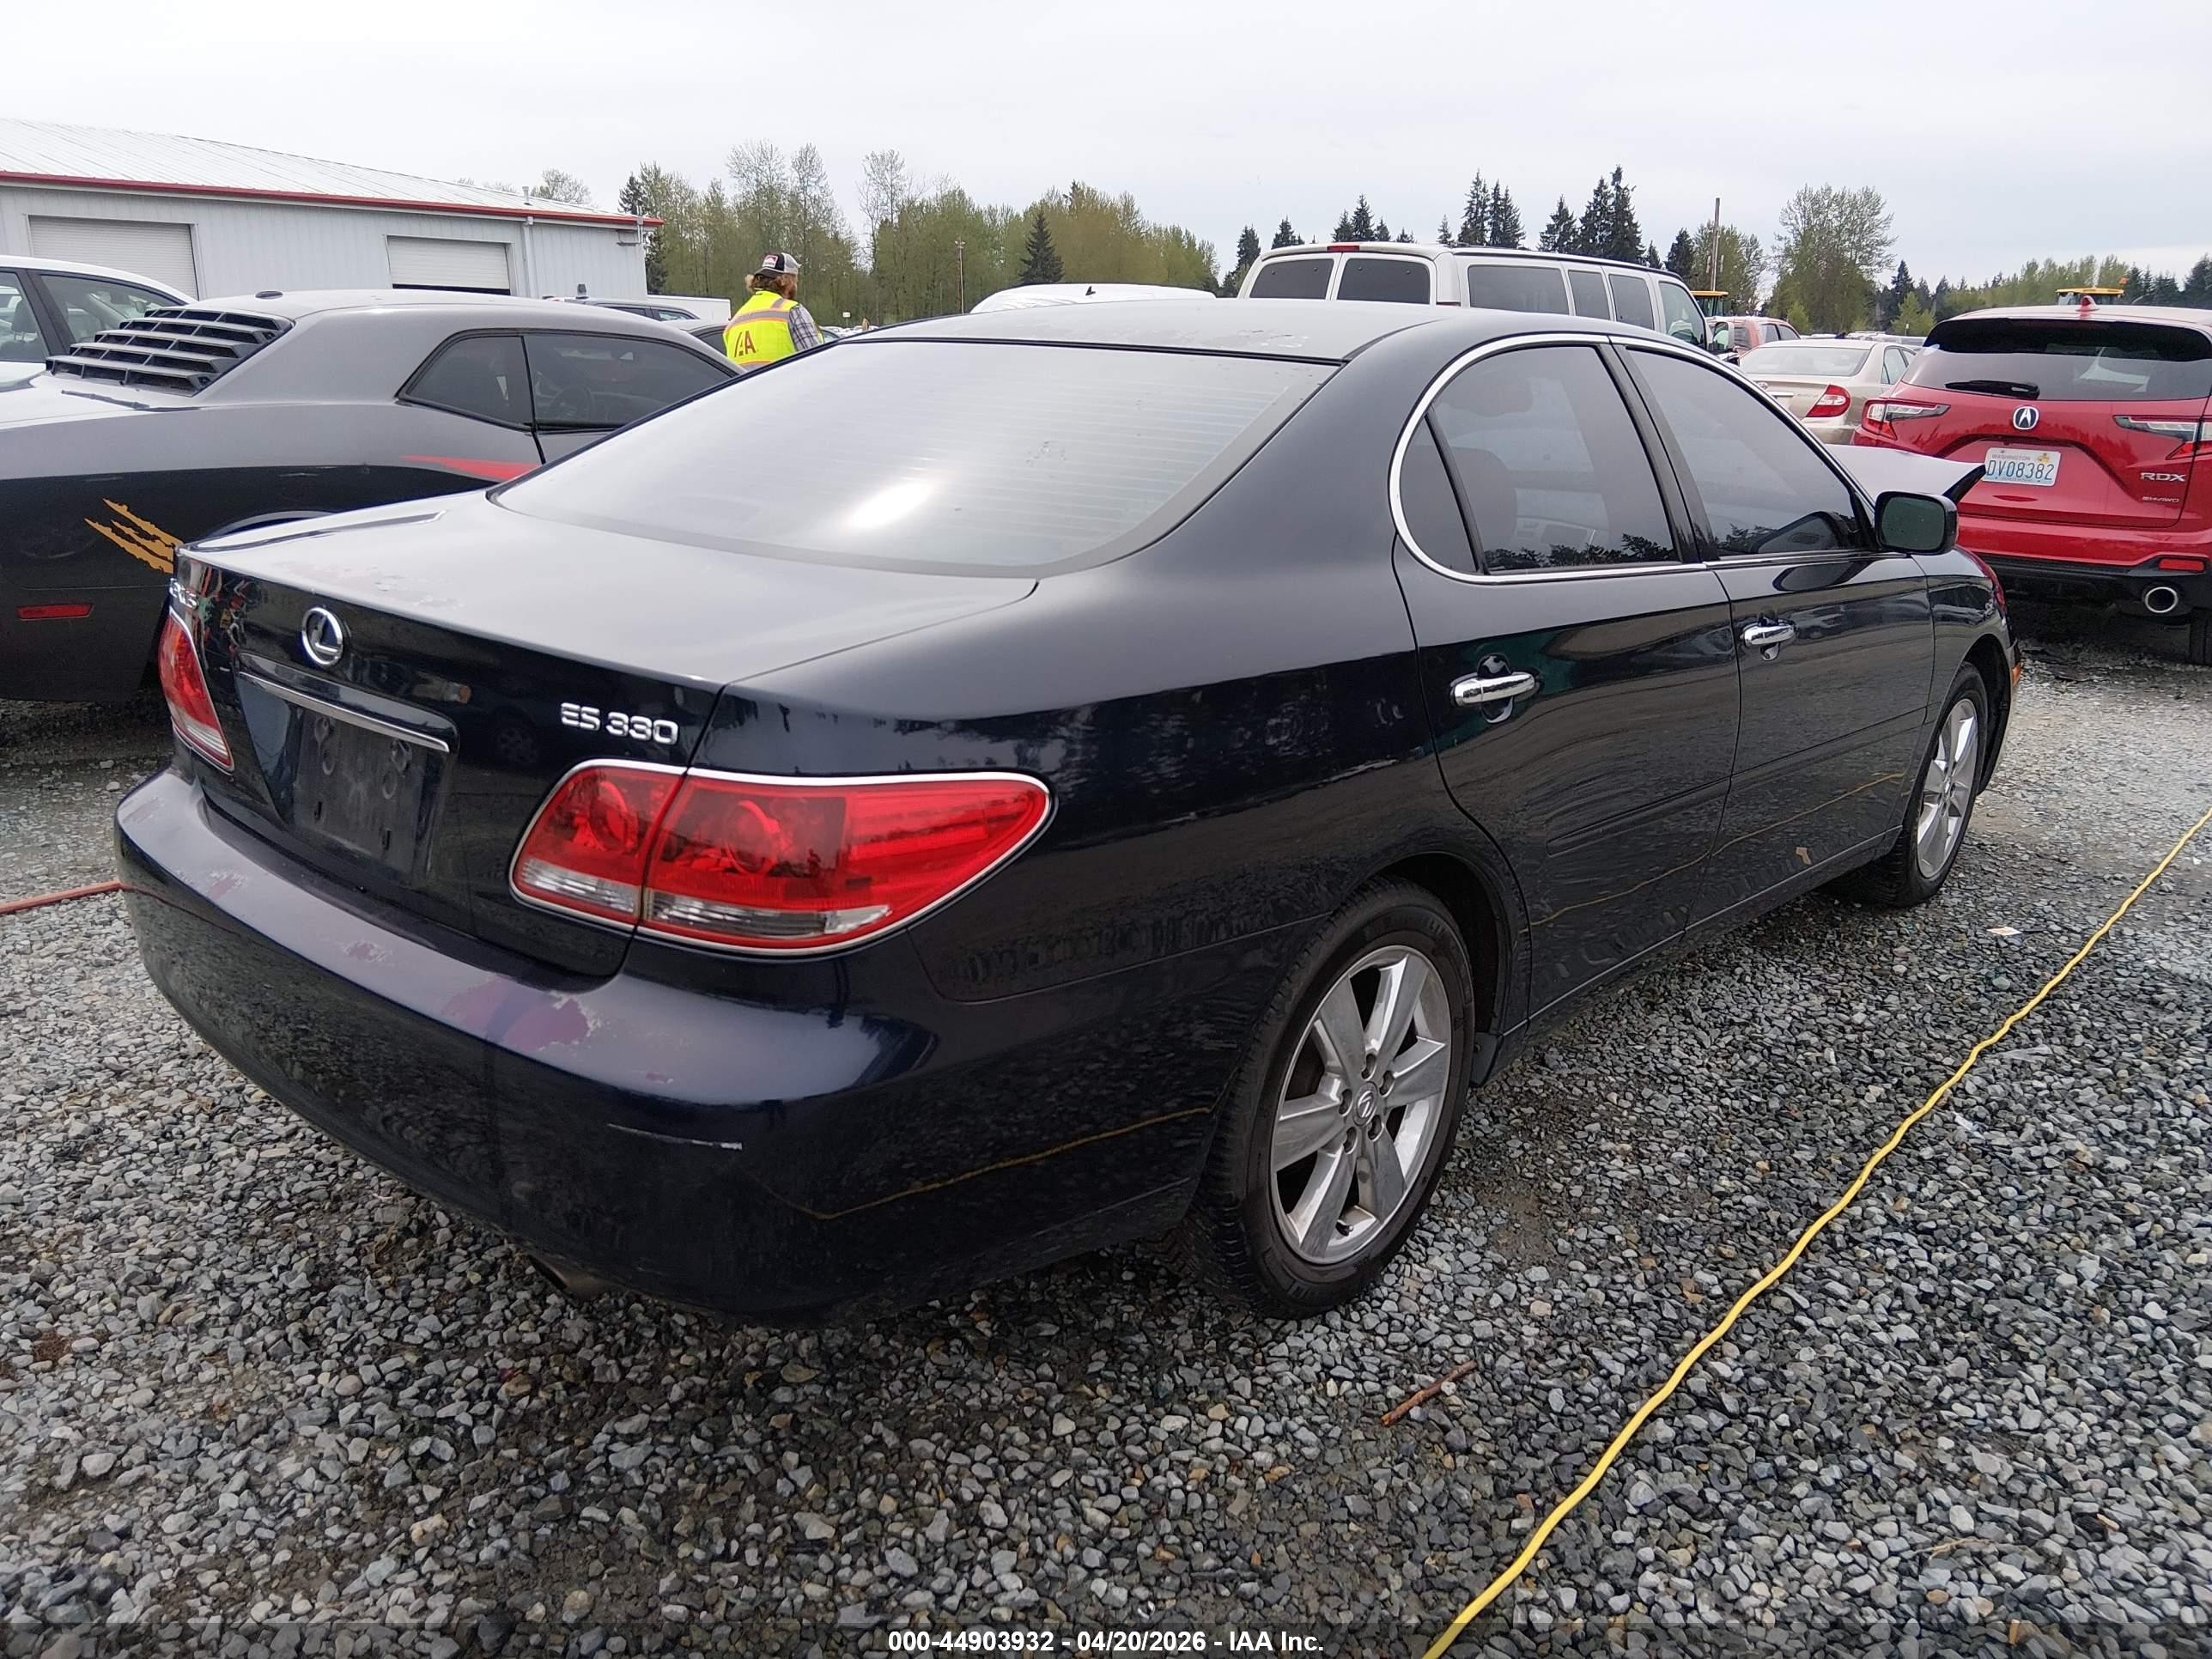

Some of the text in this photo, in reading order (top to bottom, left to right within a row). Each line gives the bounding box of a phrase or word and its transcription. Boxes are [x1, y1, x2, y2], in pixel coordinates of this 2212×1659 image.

[1986, 459, 2055, 481] DV08382
[2140, 471, 2186, 482] RDX
[561, 702, 679, 745] ES 330
